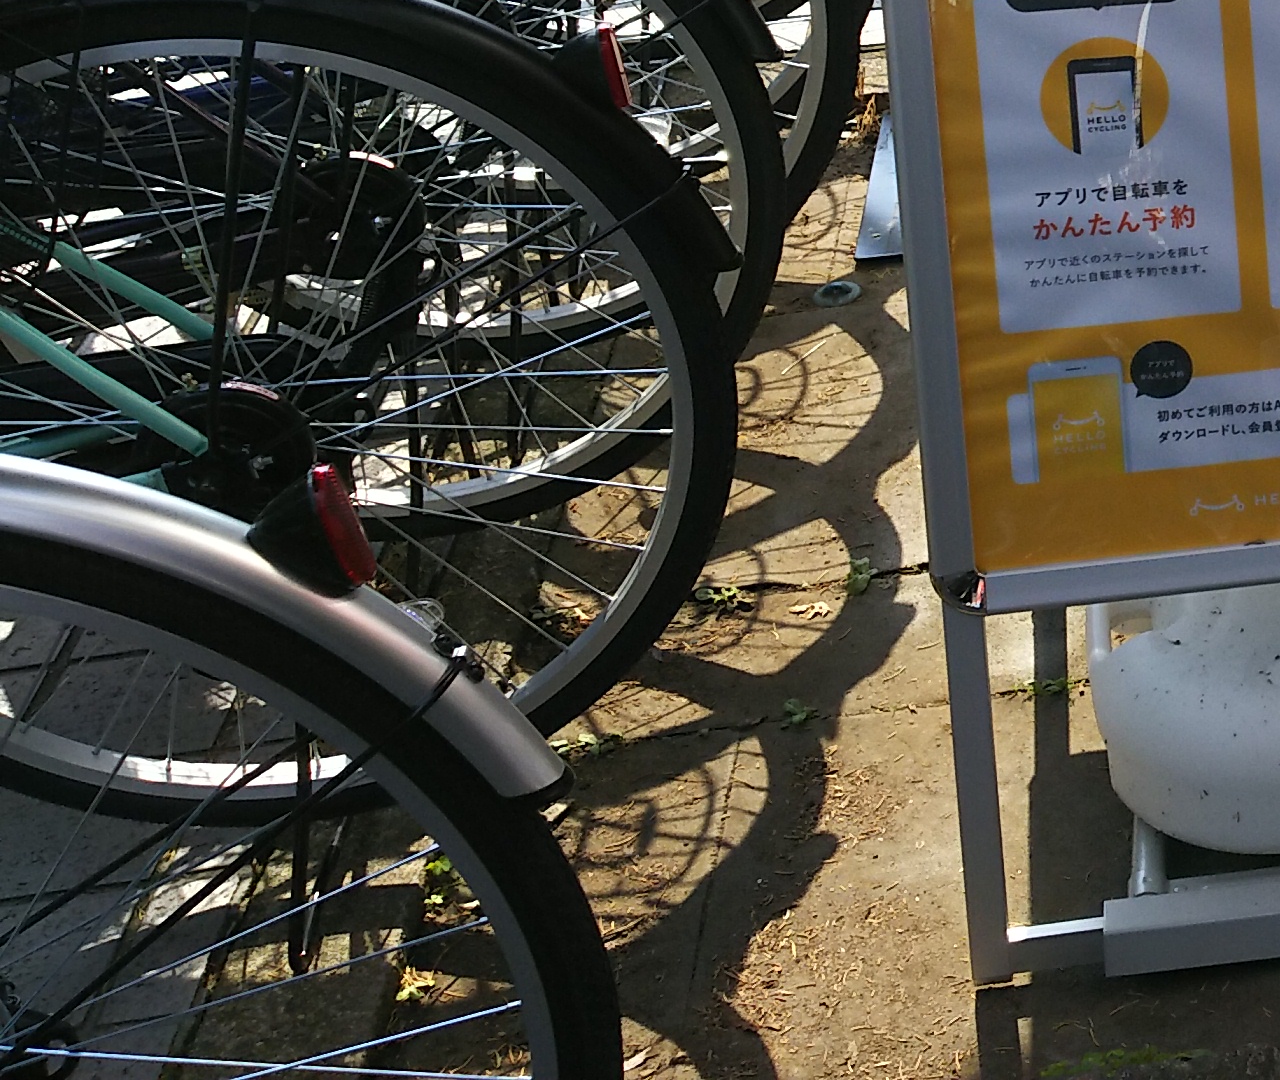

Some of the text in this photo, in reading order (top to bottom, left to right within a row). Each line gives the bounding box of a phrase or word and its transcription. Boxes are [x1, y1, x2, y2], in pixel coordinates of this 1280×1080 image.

[1087, 114, 1127, 125] HELLO
[1088, 124, 1127, 133] CYCLING
[1035, 179, 1189, 208] アプリで自転車を
[1033, 204, 1197, 241] かんたん予約
[1053, 431, 1105, 444] HELLO
